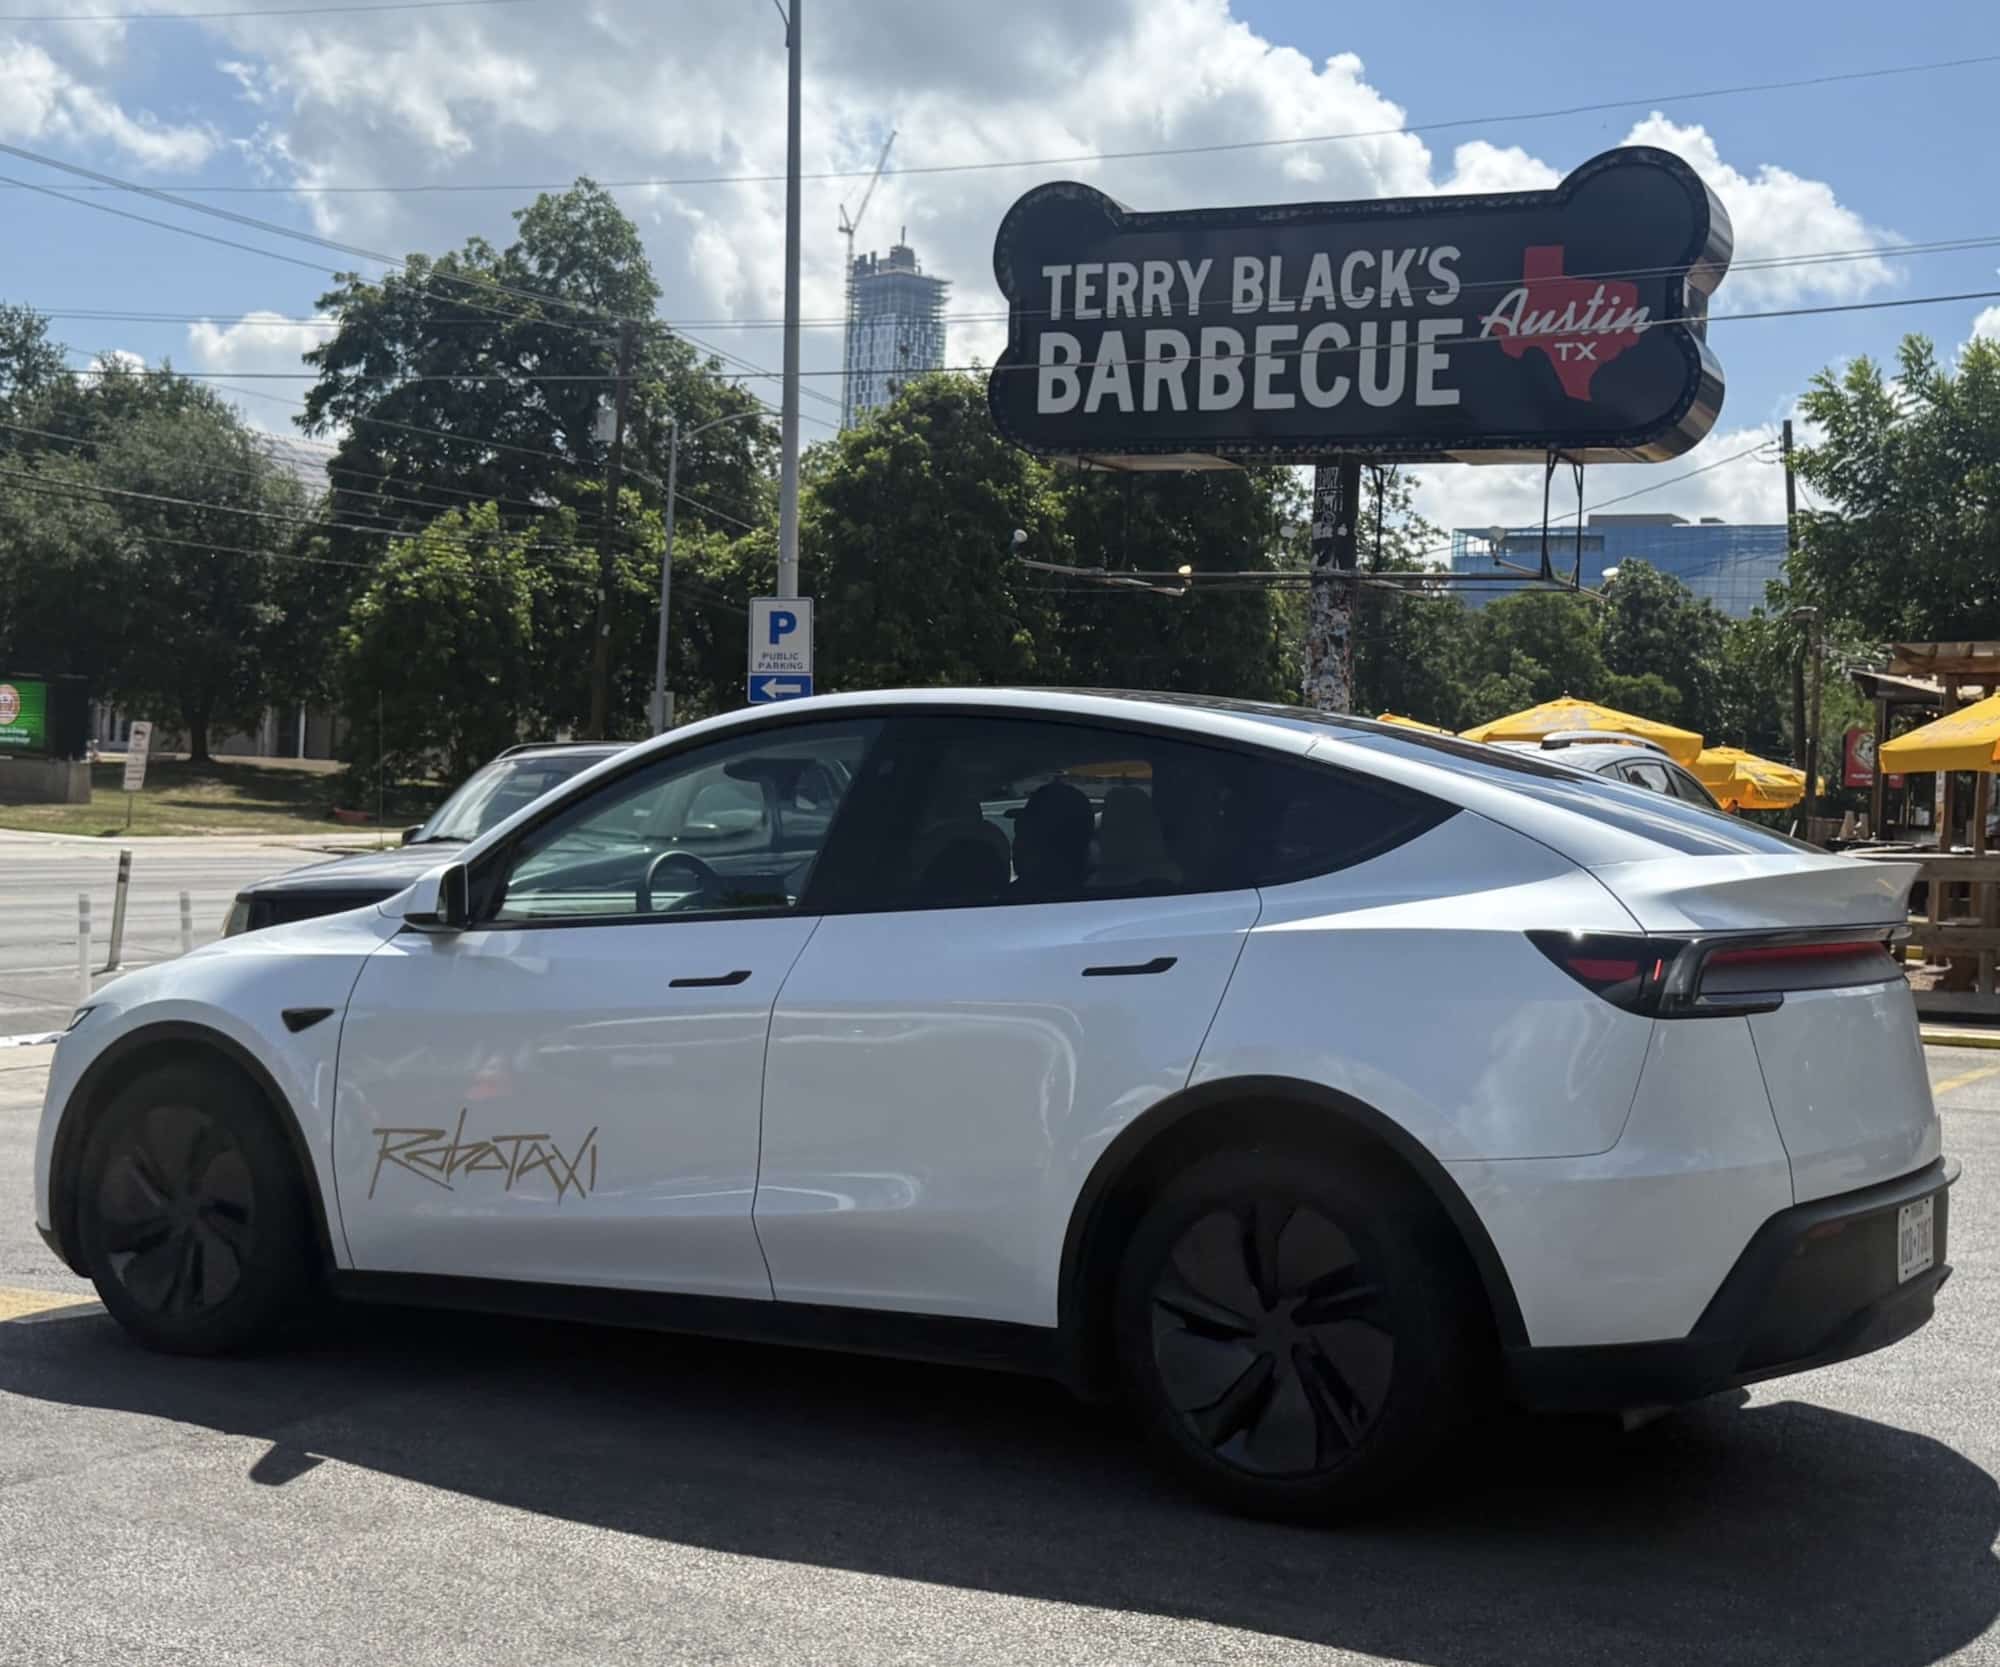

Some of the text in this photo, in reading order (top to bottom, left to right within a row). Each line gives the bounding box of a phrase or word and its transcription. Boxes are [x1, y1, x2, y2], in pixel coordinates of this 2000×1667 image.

[1041, 245, 1462, 320] TERRY BLACK'S
[1479, 283, 1654, 339] Austin
[1036, 318, 1464, 415] BARBECUE
[1554, 342, 1598, 361] TX
[769, 610, 798, 645] P
[758, 661, 803, 671] PARKING
[762, 652, 800, 661] PUBLIC
